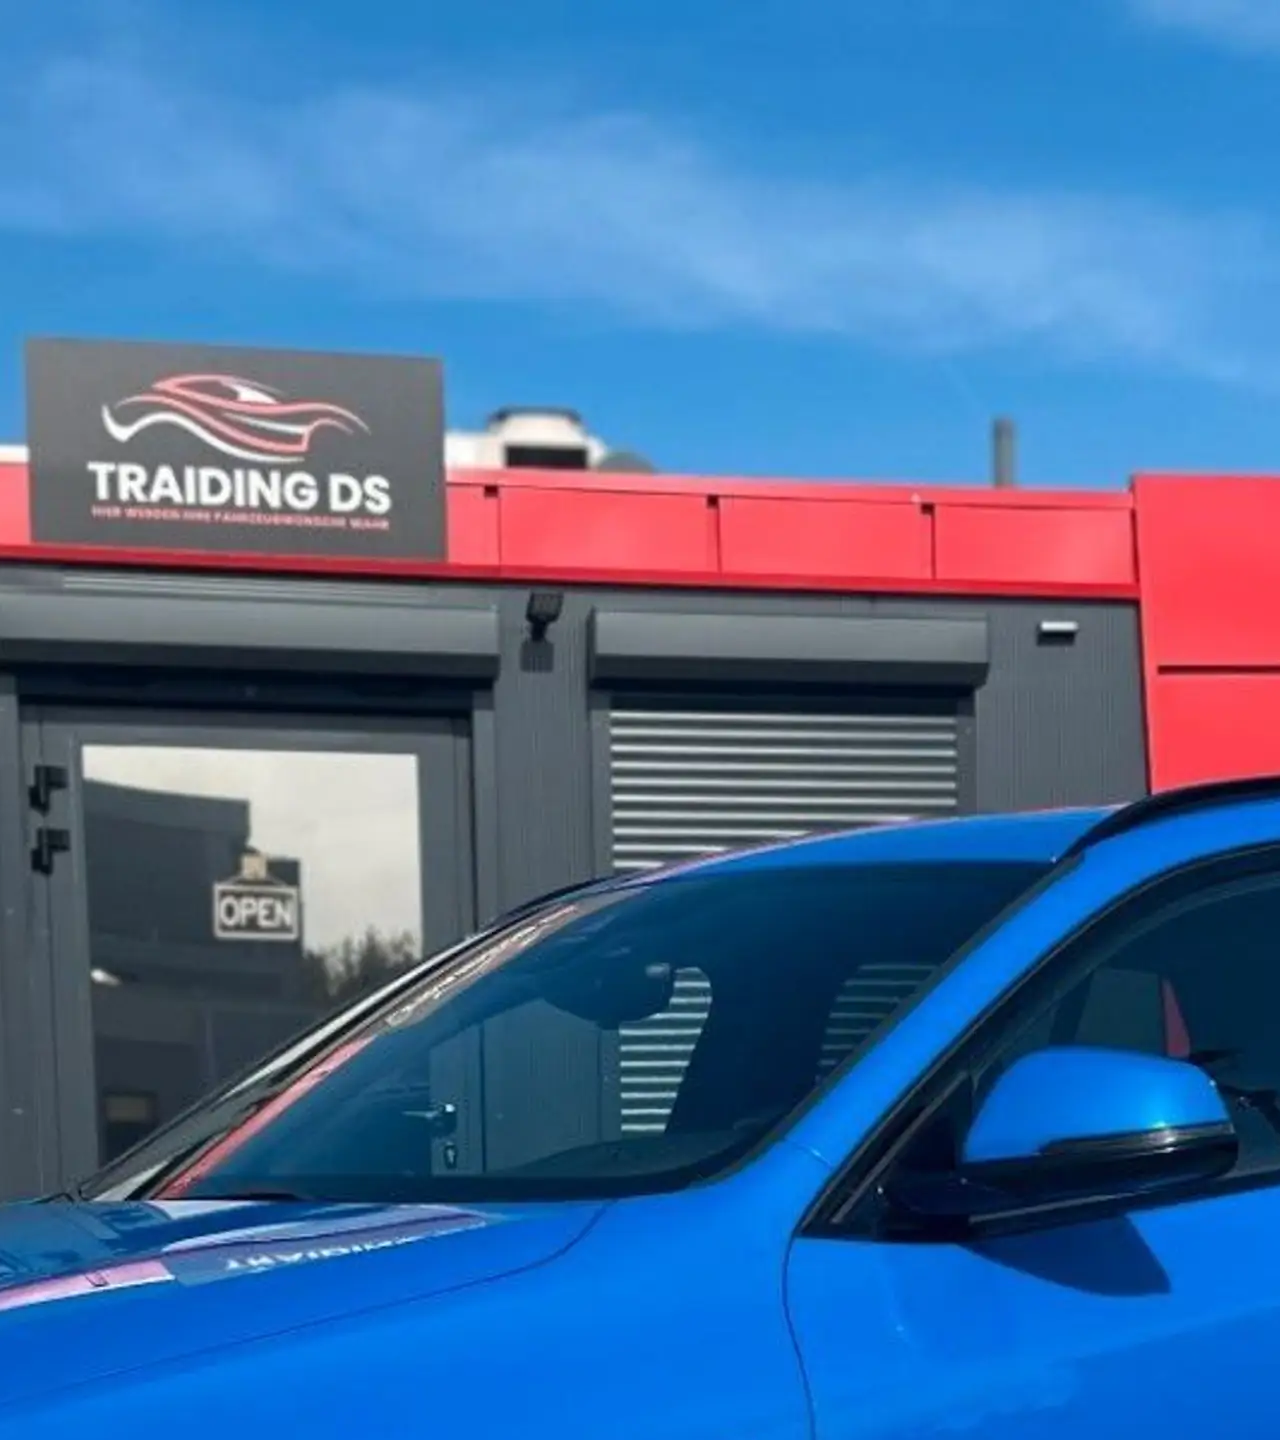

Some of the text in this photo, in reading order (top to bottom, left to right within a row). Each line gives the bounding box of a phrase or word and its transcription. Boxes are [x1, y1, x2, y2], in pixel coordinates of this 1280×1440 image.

[87, 461, 392, 515] TRAIDING DS
[220, 896, 291, 928] OPEN
